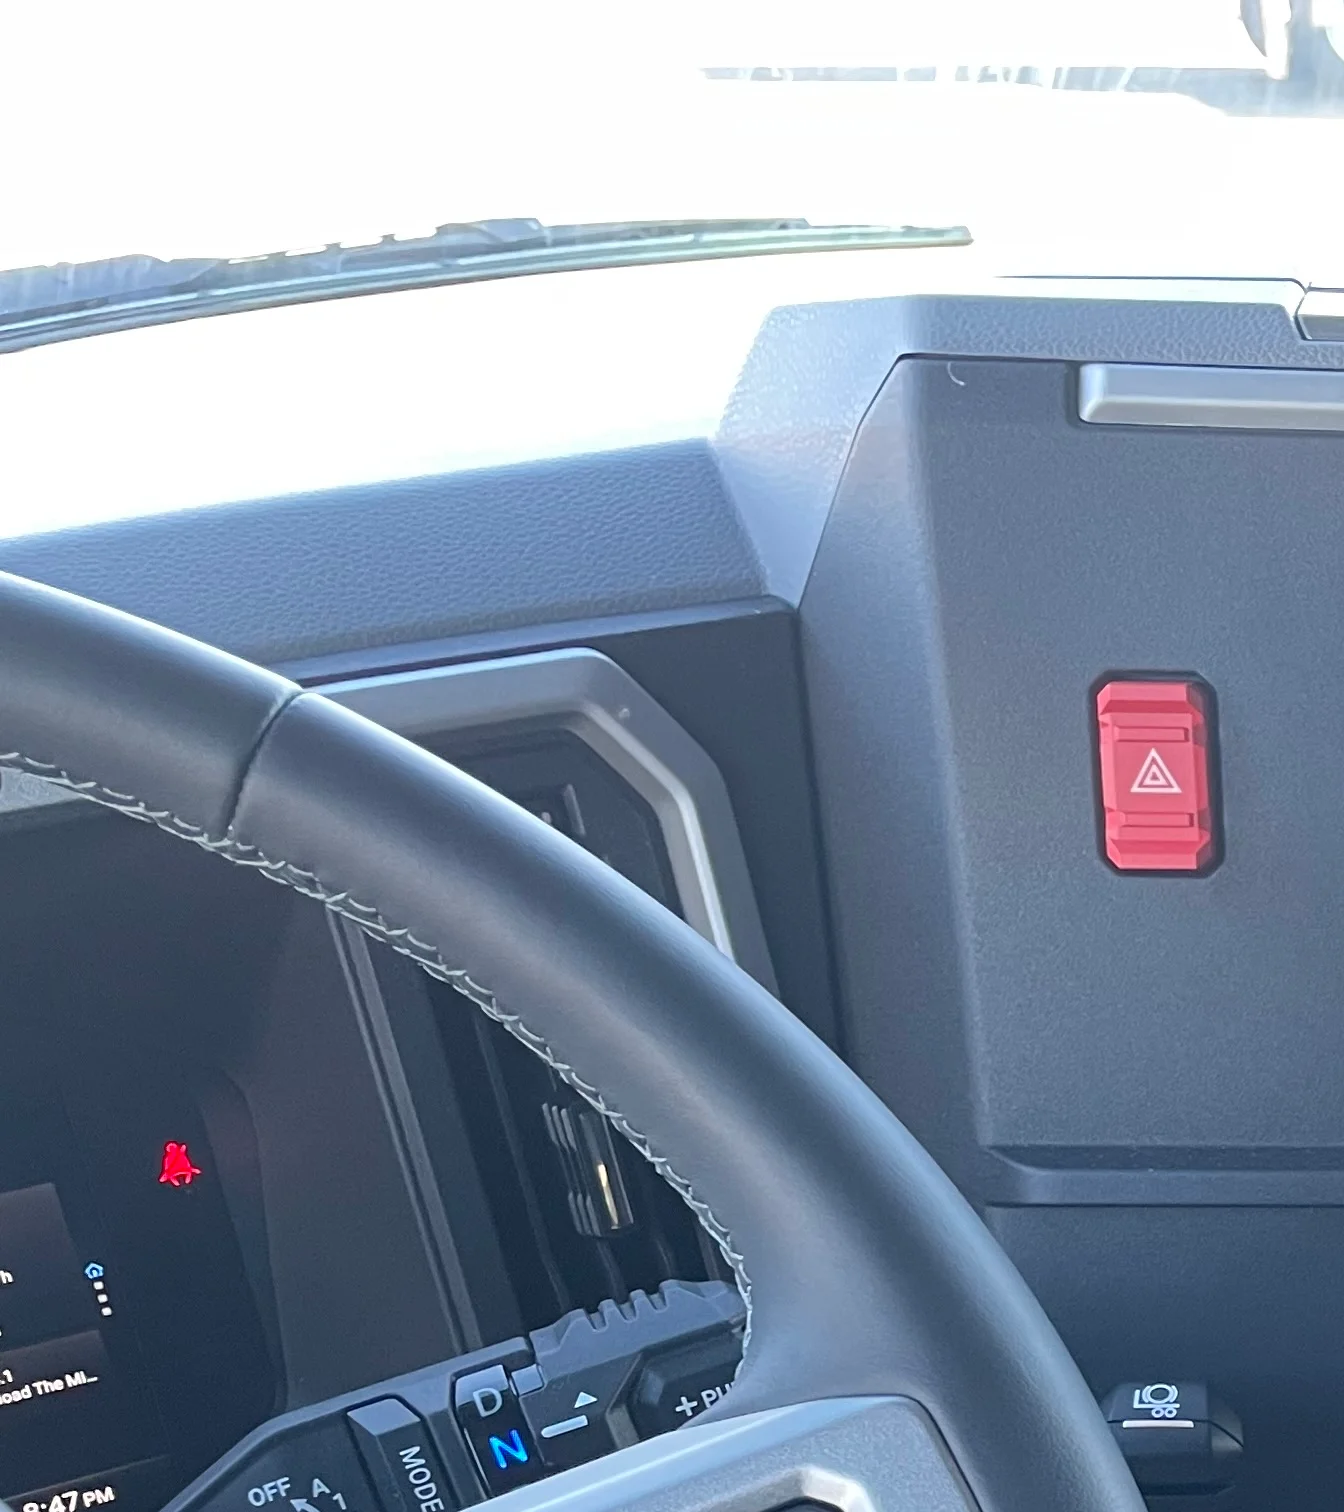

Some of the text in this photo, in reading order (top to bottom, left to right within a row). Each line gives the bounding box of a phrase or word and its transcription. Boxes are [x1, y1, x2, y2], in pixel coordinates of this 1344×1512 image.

[31, 1380, 65, 1396] The
[472, 1387, 502, 1418] D
[488, 1428, 529, 1470] N
[82, 1486, 116, 1508] PM
[247, 1476, 291, 1507] OFF
[312, 1478, 331, 1498] A
[332, 1492, 347, 1511] 1
